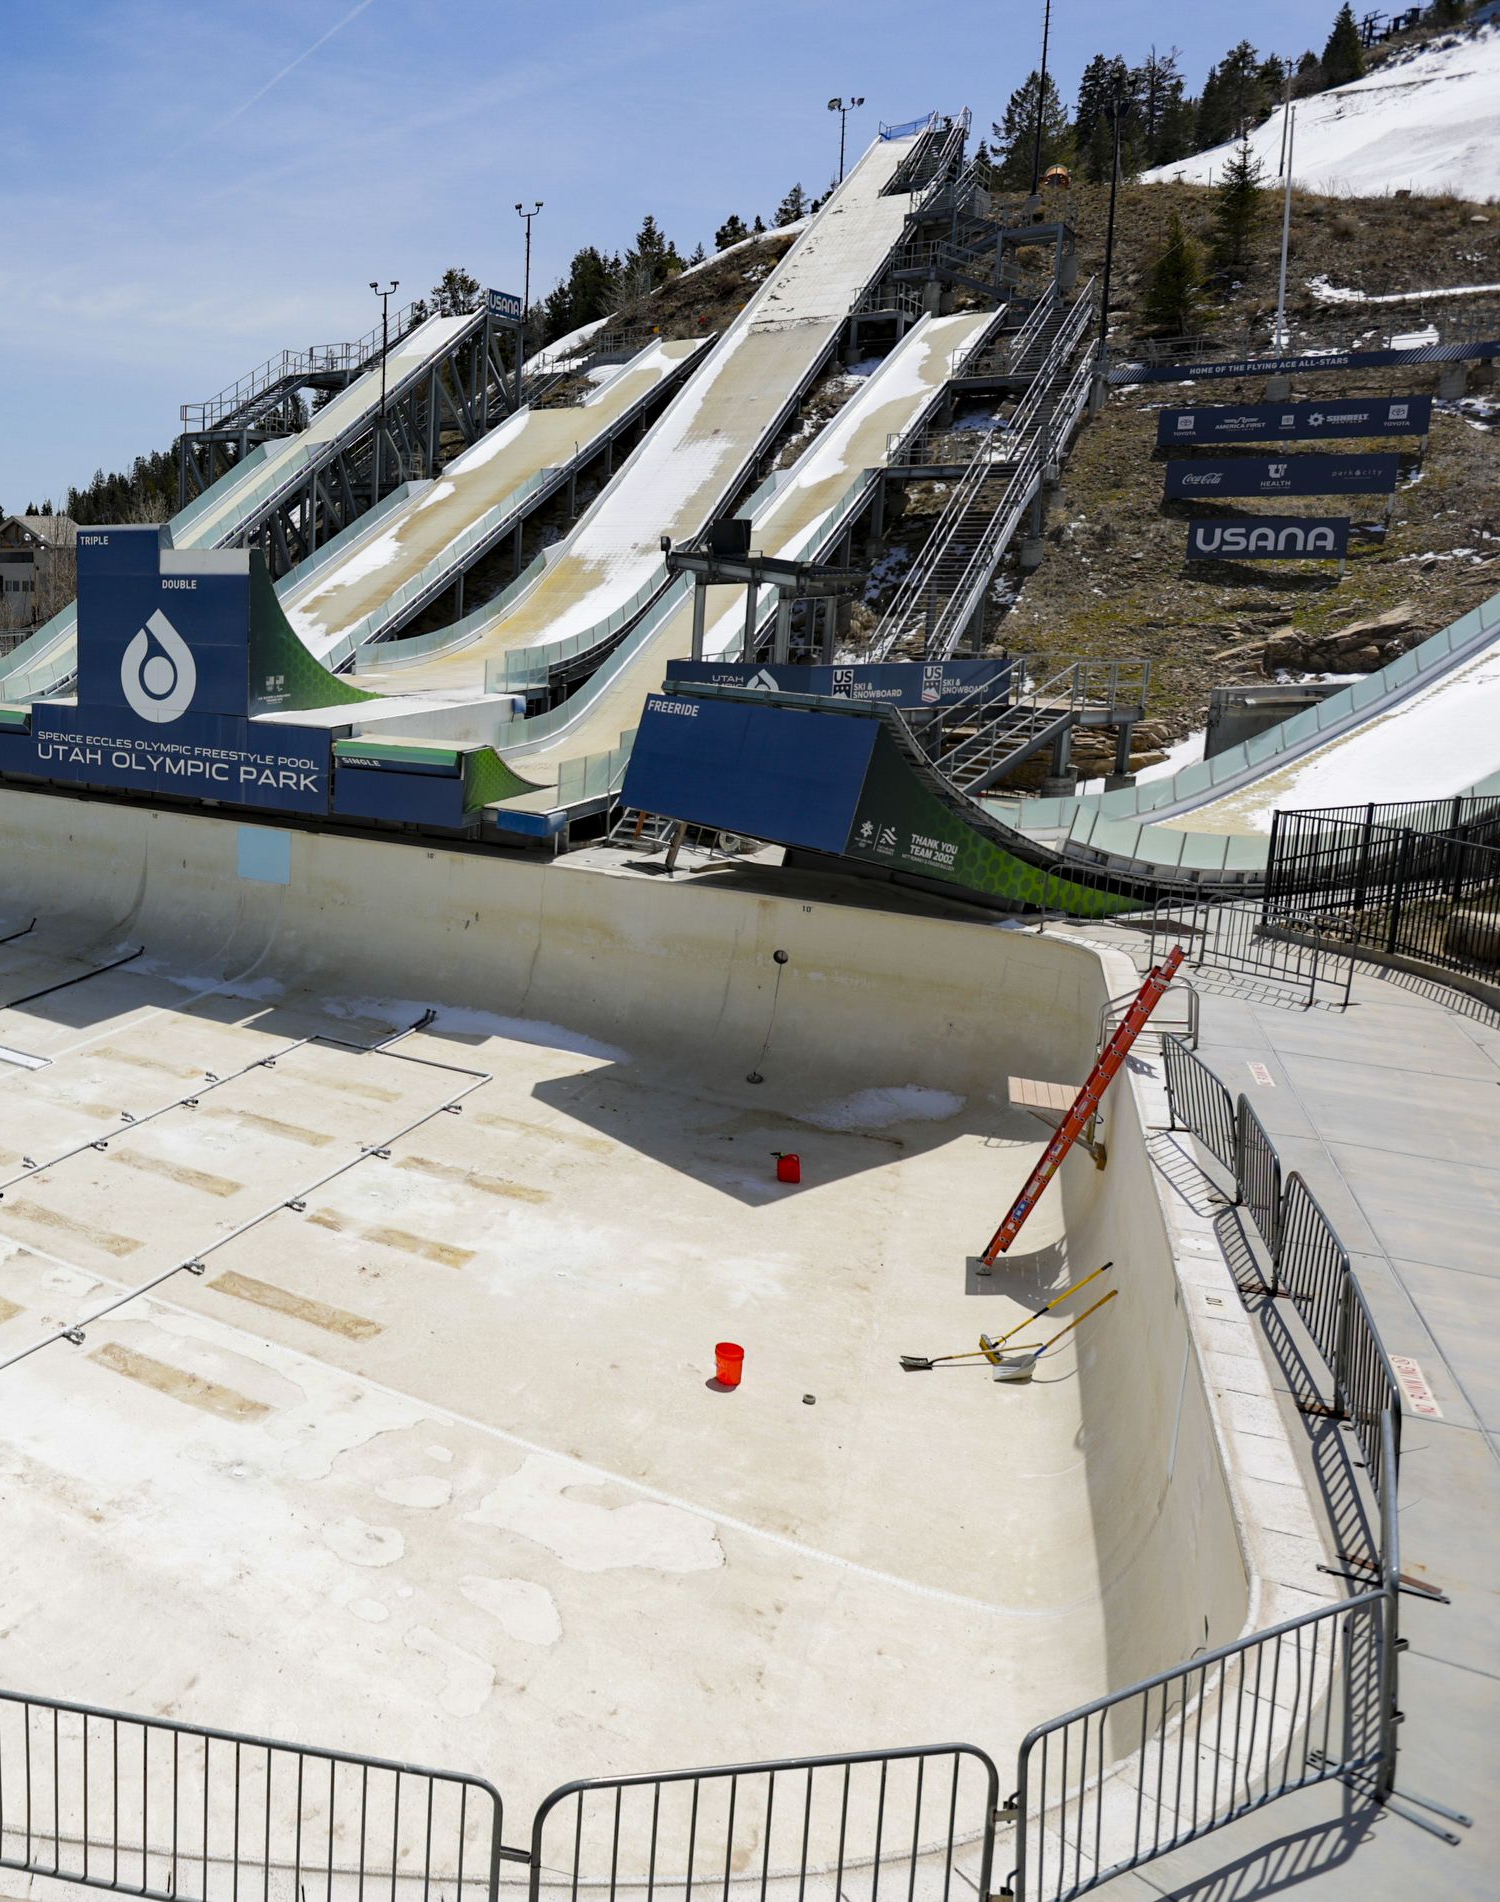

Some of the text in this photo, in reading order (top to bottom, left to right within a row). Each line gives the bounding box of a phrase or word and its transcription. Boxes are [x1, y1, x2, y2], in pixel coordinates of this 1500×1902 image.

[490, 293, 520, 316] USANA
[1189, 366, 1213, 375] HOME
[1246, 362, 1277, 371] FLYING
[1299, 357, 1349, 367] ALL-STARS
[80, 536, 109, 545] TRIPLE
[1195, 527, 1335, 551] USANA
[162, 579, 197, 589] DOUBLE
[712, 675, 744, 683] UTAH
[834, 670, 852, 683] US
[924, 667, 941, 680] US
[854, 682, 873, 691] SKI &
[943, 679, 954, 687] SKI
[853, 688, 902, 699] SNOWBOARD
[648, 699, 700, 717] FREERIDE
[38, 731, 320, 770] SPENCE ECCLES OLYMPIC FREESTYLE POOL
[38, 743, 319, 793] UTAH OLYMPIC PARK
[341, 757, 381, 767] SINGLE
[911, 833, 959, 855] THANK YOU
[910, 845, 933, 860] TEAM
[933, 851, 955, 865] 2002
